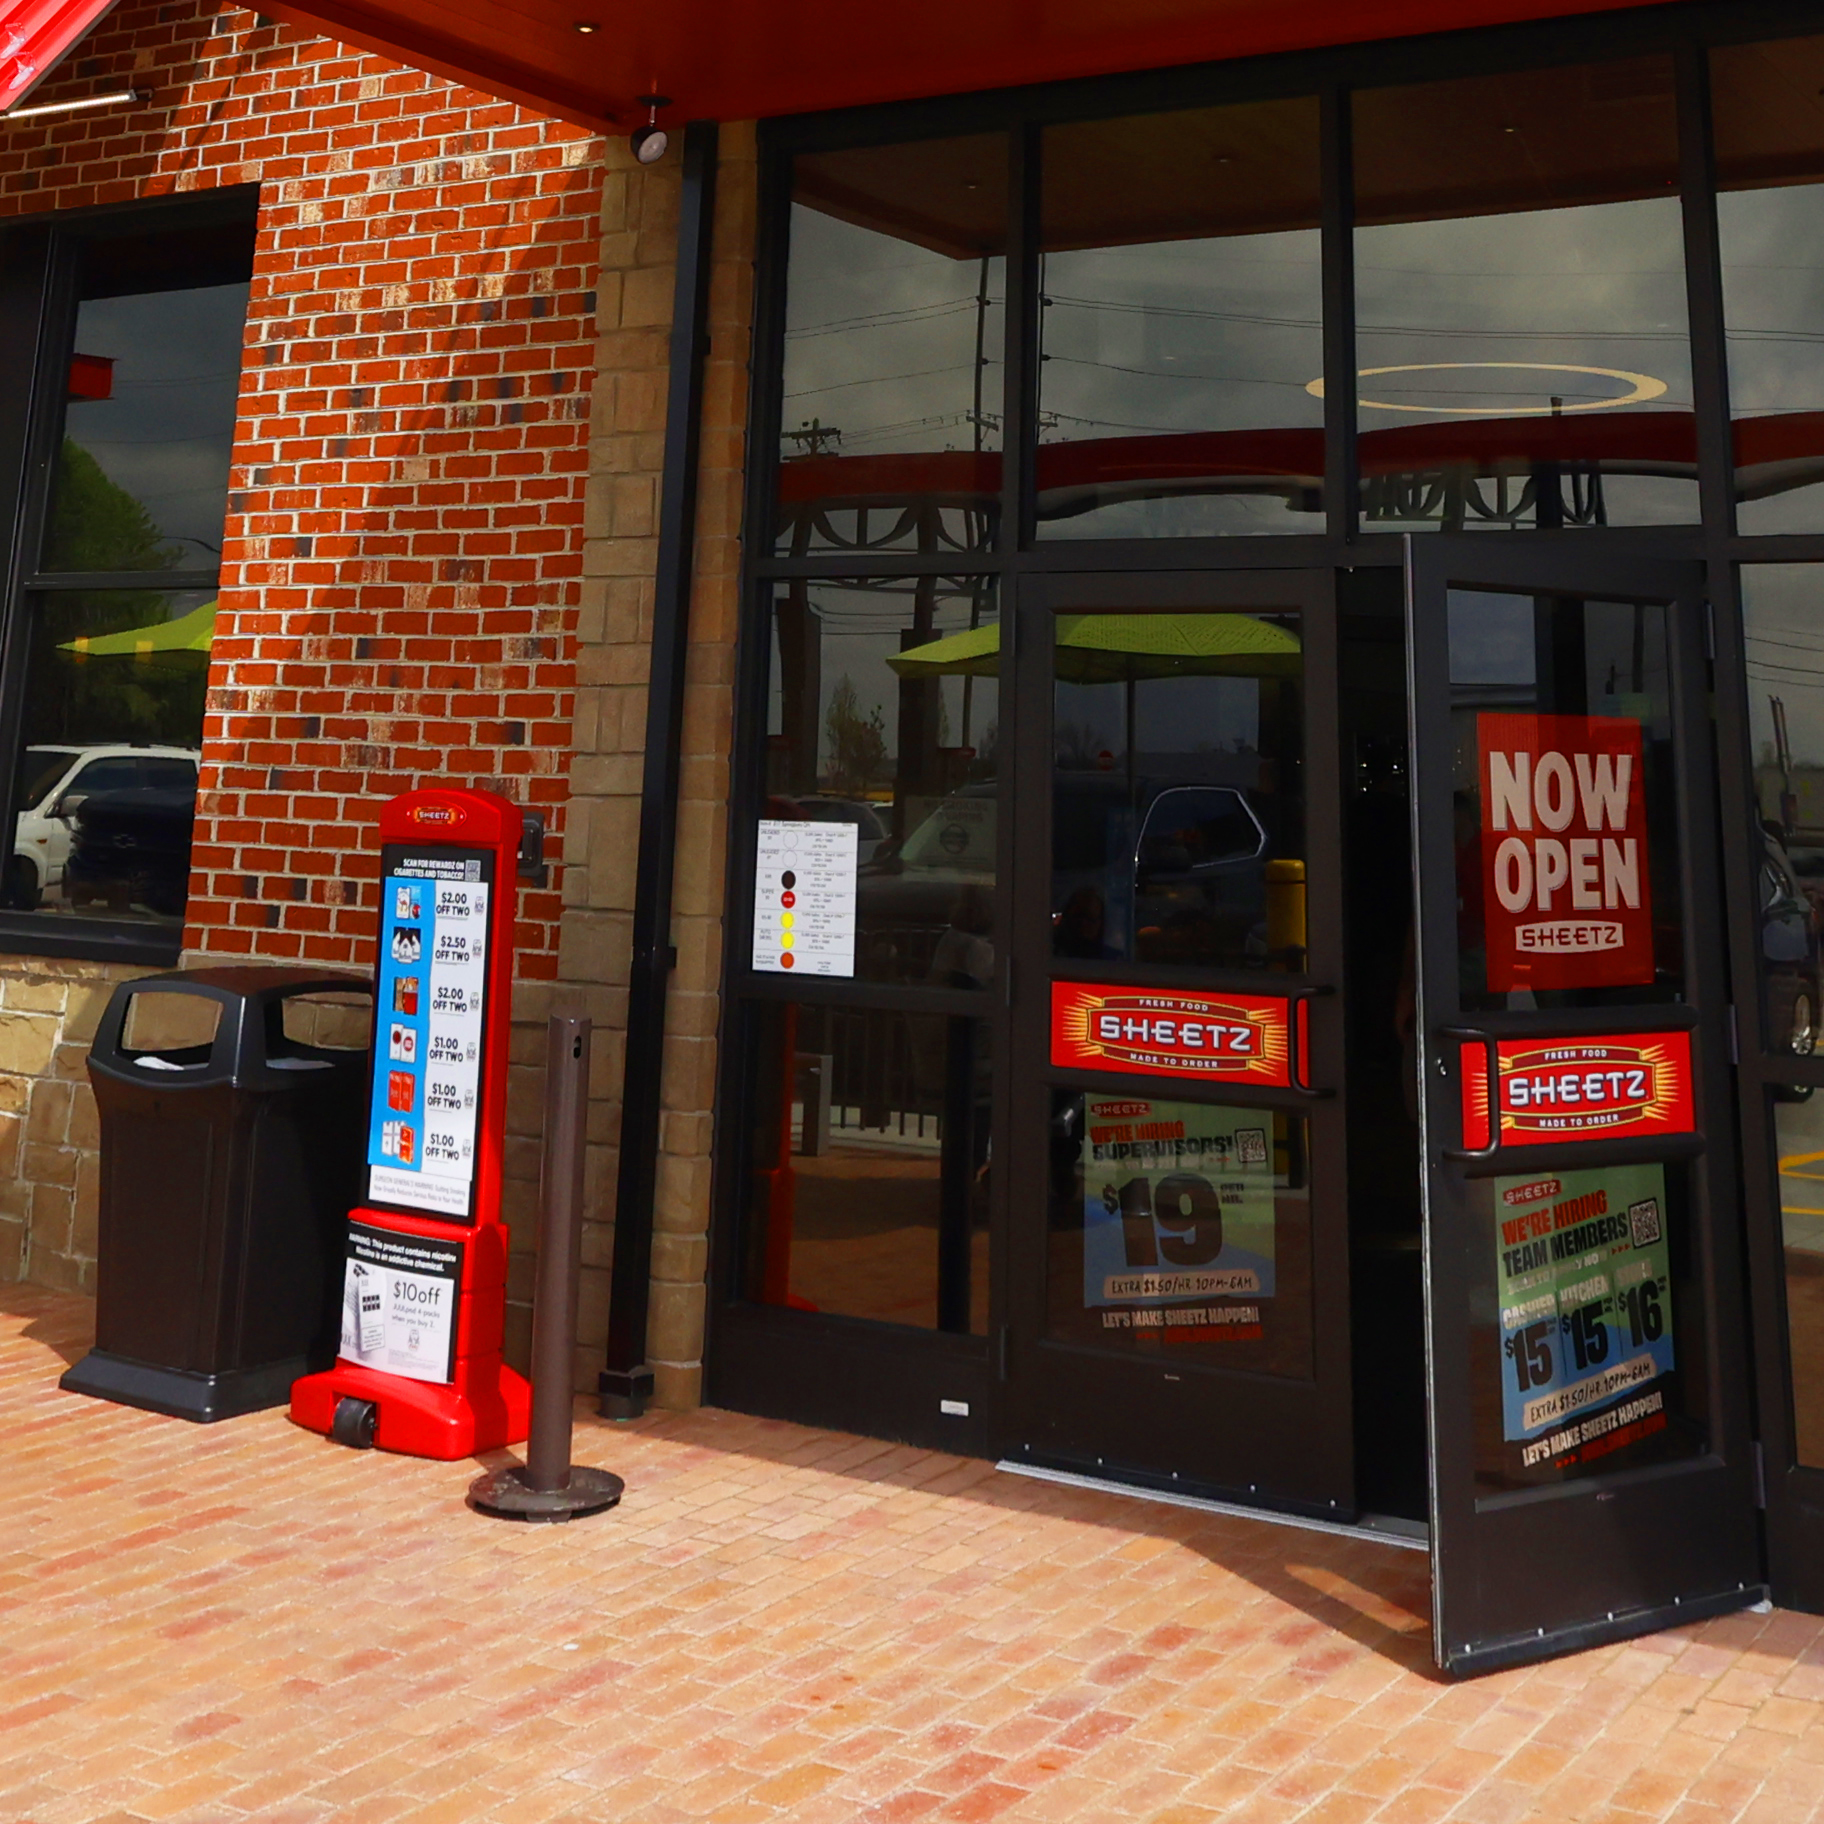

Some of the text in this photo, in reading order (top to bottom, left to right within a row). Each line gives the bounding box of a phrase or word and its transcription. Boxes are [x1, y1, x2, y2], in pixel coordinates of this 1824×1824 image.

[1489, 751, 1633, 833] NOW
[1494, 836, 1641, 914] OPEN
[441, 892, 468, 904] $2.00
[436, 904, 470, 917] OFF TWO
[440, 935, 466, 948] $2.50
[1521, 925, 1618, 947] SHEETZ
[435, 950, 470, 962] OFF TWO
[438, 987, 464, 1000] $2.00
[432, 1000, 468, 1013] OFF TWO
[1139, 998, 1209, 1012] FRESH FOOD
[1099, 1015, 1251, 1052] SHEETZ
[434, 1036, 459, 1050] $1.00
[429, 1049, 464, 1063] OFF TWO
[1130, 1053, 1219, 1068] MADE TO ORDER
[1544, 1048, 1608, 1061] FRESH FOOD
[432, 1082, 456, 1096] $1.00
[1508, 1069, 1646, 1107] SHEETZ
[427, 1096, 462, 1110] OFF TWO
[1093, 1102, 1148, 1115] SHEETZ
[1538, 1114, 1620, 1128] MADE TO ORDER
[430, 1134, 454, 1147] $1.00
[1092, 1135, 1233, 1161] SUPERVISORS!
[425, 1146, 460, 1161] OFF TWO
[1506, 1181, 1558, 1204] SHEETZ
[1501, 1188, 1609, 1246] WE'RE HIRING
[1502, 1211, 1629, 1278] TEAM MEMBERS
[1112, 1279, 1141, 1294] EXTRA
[1102, 1306, 1259, 1328] LET'S MAKE SHEETZ HAPPEN!
[1618, 1280, 1663, 1348] $16
[1562, 1300, 1608, 1371] $15
[1504, 1320, 1552, 1393] $15
[1530, 1398, 1557, 1423] EXTRA
[1522, 1438, 1551, 1468] LET'S
[1550, 1426, 1581, 1455] MAKE
[1580, 1410, 1618, 1442] SHEETZ
[1618, 1390, 1664, 1426] HAPPEN!
